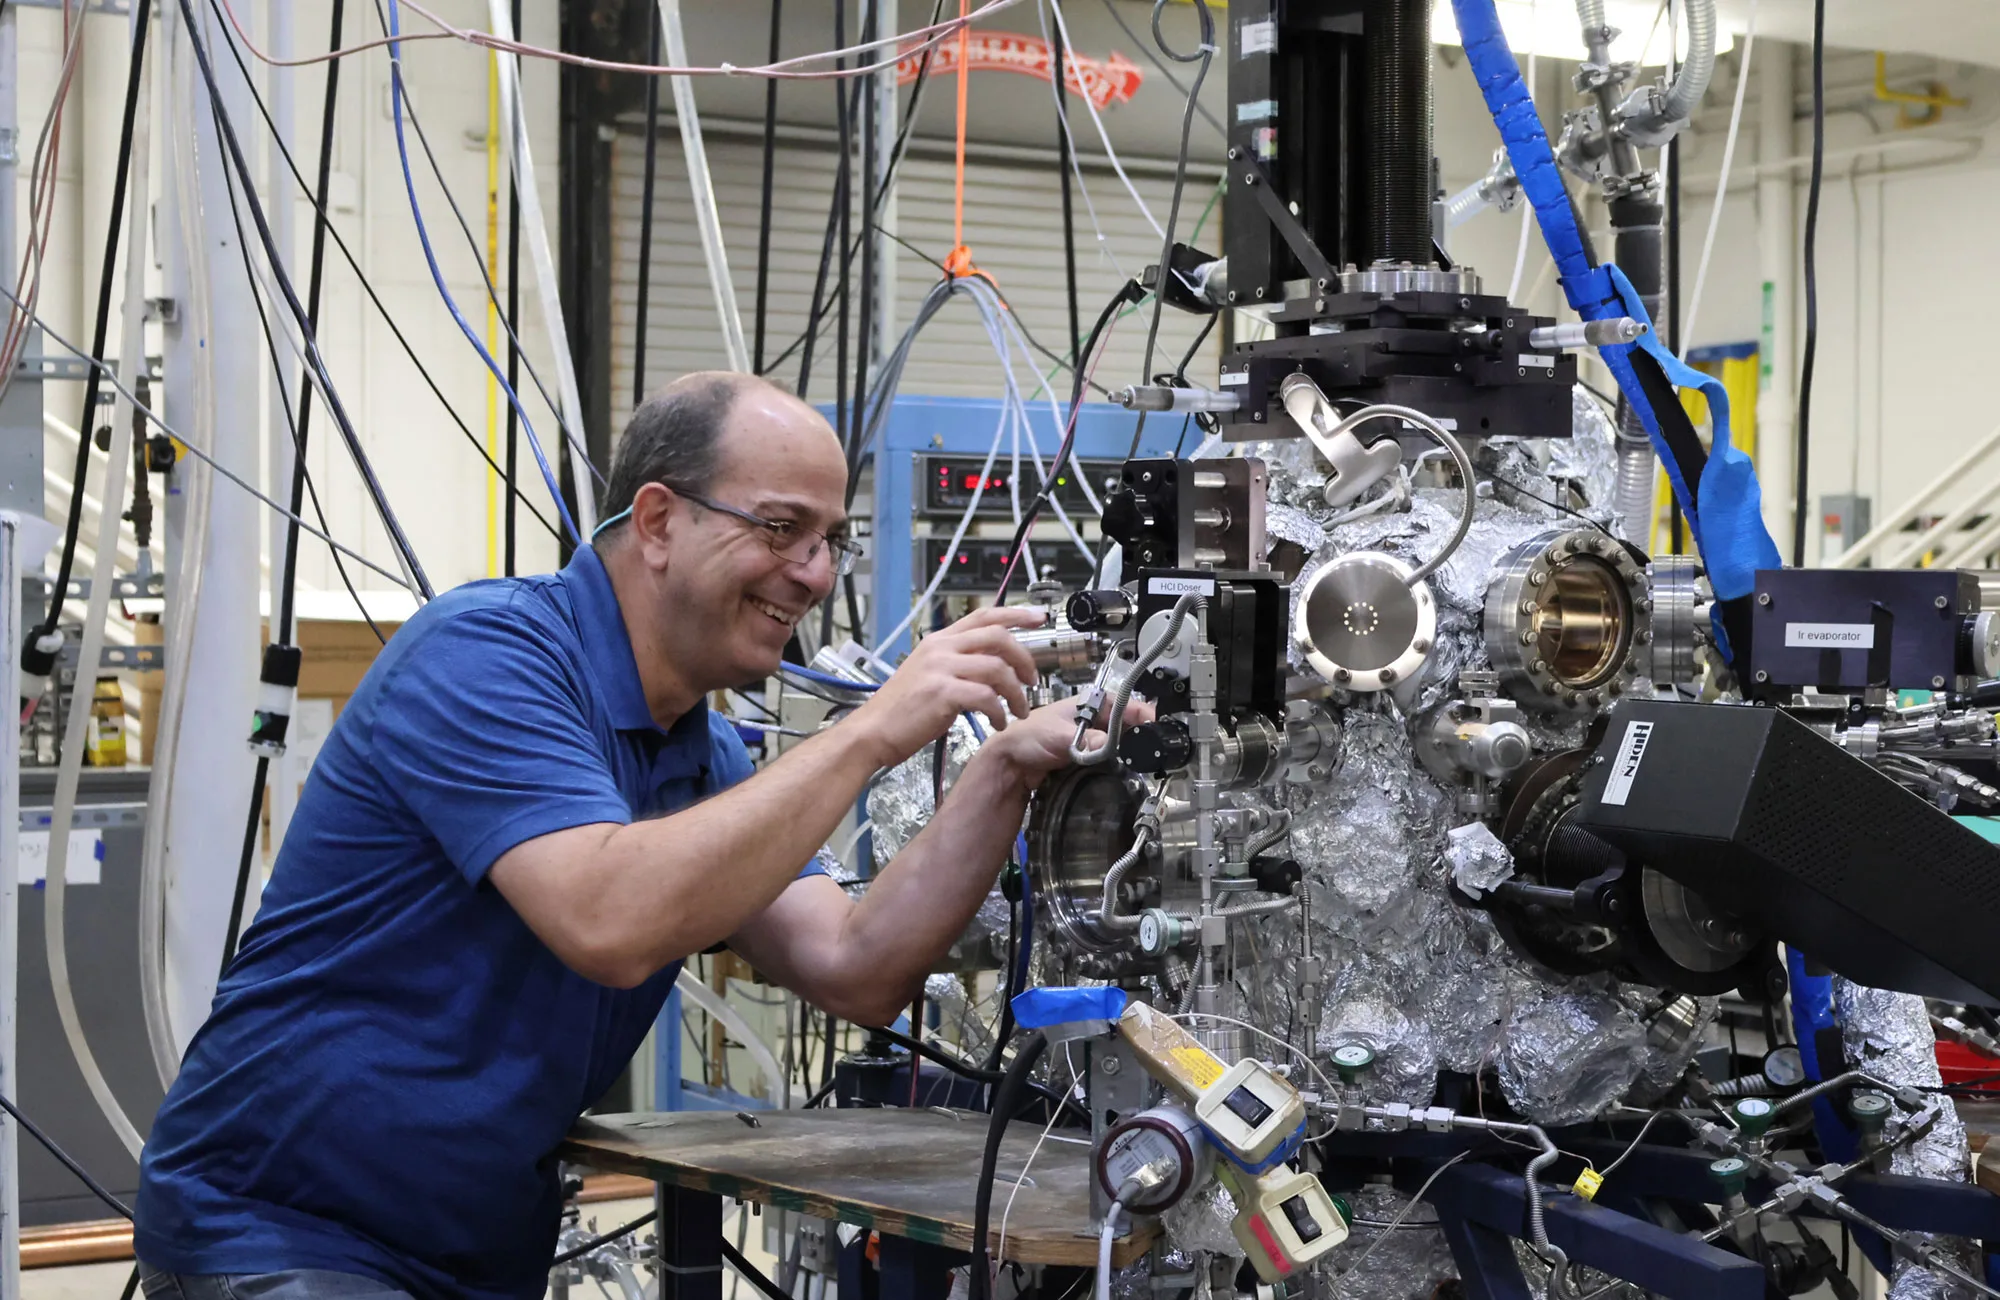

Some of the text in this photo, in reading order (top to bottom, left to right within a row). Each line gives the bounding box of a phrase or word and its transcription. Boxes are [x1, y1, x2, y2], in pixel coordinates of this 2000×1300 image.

[1047, 48, 1113, 101] OOR
[1177, 583, 1202, 592] Doser
[1807, 631, 1861, 641] evaporator
[1623, 724, 1651, 778] HIDEN
